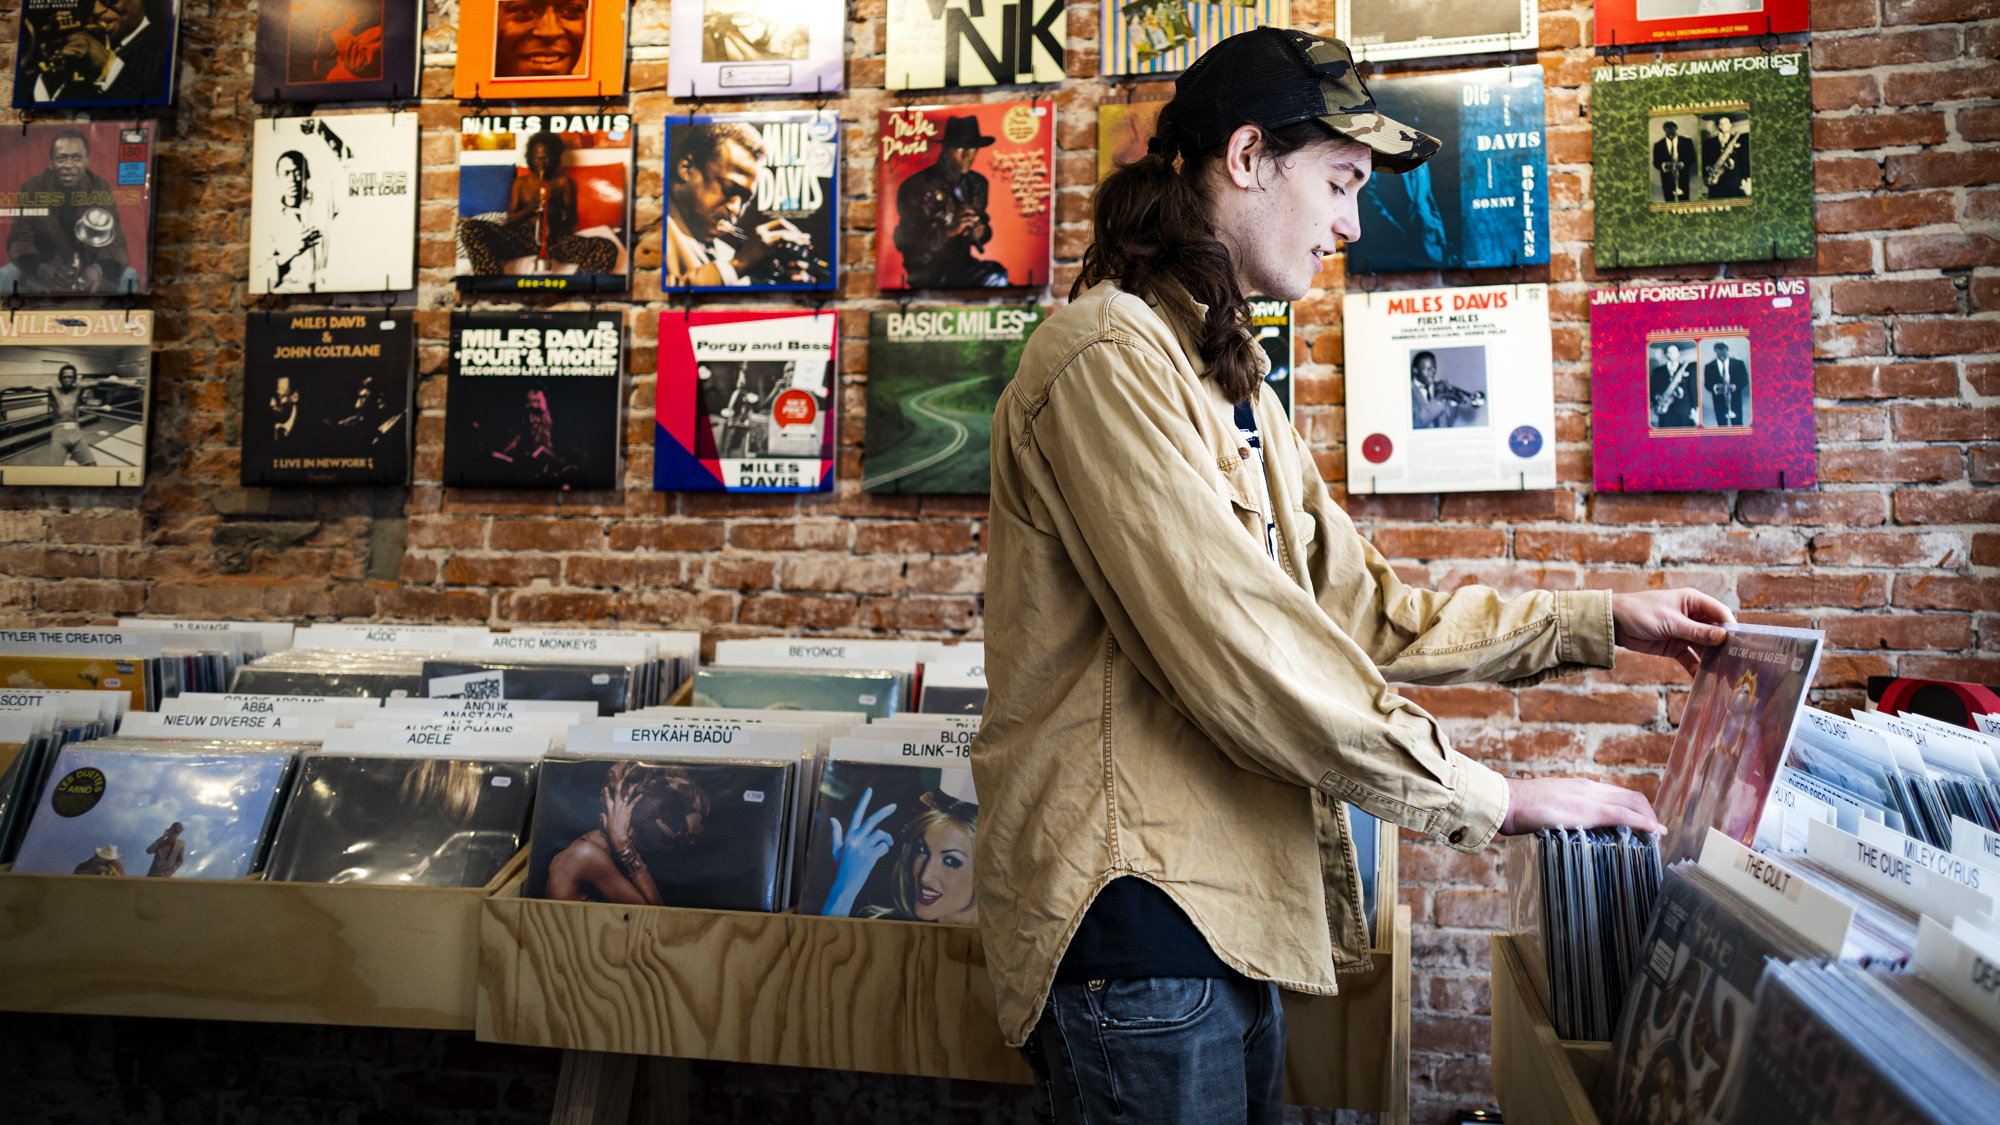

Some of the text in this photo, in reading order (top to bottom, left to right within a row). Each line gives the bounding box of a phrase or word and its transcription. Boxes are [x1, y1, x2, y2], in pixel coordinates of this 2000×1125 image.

[1733, 53, 1803, 73] FORREST
[1462, 85, 1490, 106] DIG
[461, 114, 630, 134] MILES DAVIS
[762, 123, 809, 167] MIL
[1477, 131, 1541, 151] DAVIS
[349, 171, 408, 188] MILES
[349, 186, 359, 196] IN
[379, 184, 407, 195] LOUIS
[757, 166, 823, 211] DAVIS
[71, 190, 141, 206] DAVIS
[1472, 197, 1516, 209] SONNY
[1521, 165, 1536, 257] ROLLINS
[1672, 205, 1732, 215] VOLUME TWO
[1591, 287, 1638, 305] JIMMY
[1640, 284, 1708, 303] FORREST
[1717, 282, 1762, 299] MILES
[1764, 279, 1806, 296] DAVIS
[1388, 295, 1443, 315] MILES
[1453, 292, 1508, 311] DAVIS
[290, 316, 366, 329] MILES DAVIS
[887, 309, 1025, 337] BASIC MILES
[1418, 314, 1479, 325] FIRST MILES
[322, 331, 333, 343] &
[461, 329, 619, 348] MILES DAVIS
[273, 344, 381, 359] JOHN COLTRANE
[697, 341, 831, 352] Porgy and Bess
[526, 348, 545, 366] &
[547, 348, 618, 366] MORE
[460, 366, 617, 376] RECORDED LIVE IN CONCERT
[280, 458, 301, 468] LIVE
[740, 463, 800, 474] MILES
[740, 475, 800, 487] DAVIS
[187, 623, 230, 631] SAVAGE
[0, 632, 123, 645] TYLER THE CREATOR
[365, 631, 397, 642] ACDC
[493, 637, 597, 650] ARCTIC MONKEYS
[788, 646, 846, 658] BEYONCE
[966, 666, 984, 677] JO
[0, 695, 43, 706] SCOTT
[241, 702, 274, 713] ABBA
[464, 701, 509, 711] ANOUK
[163, 715, 281, 728] NIEUW DIVERSE A
[631, 729, 733, 744] ERYKAH BADU
[1824, 719, 1850, 741] CLASH
[1887, 722, 1928, 748] COLDPLAY
[407, 733, 453, 745] ADELE
[902, 743, 970, 758] BLINK-18
[58, 776, 74, 791] LES
[67, 785, 92, 794] ARNO
[1857, 842, 1912, 885] THE CURE
[1903, 840, 1979, 889] MILEY CYRUS
[1745, 854, 1791, 894] THE CULT
